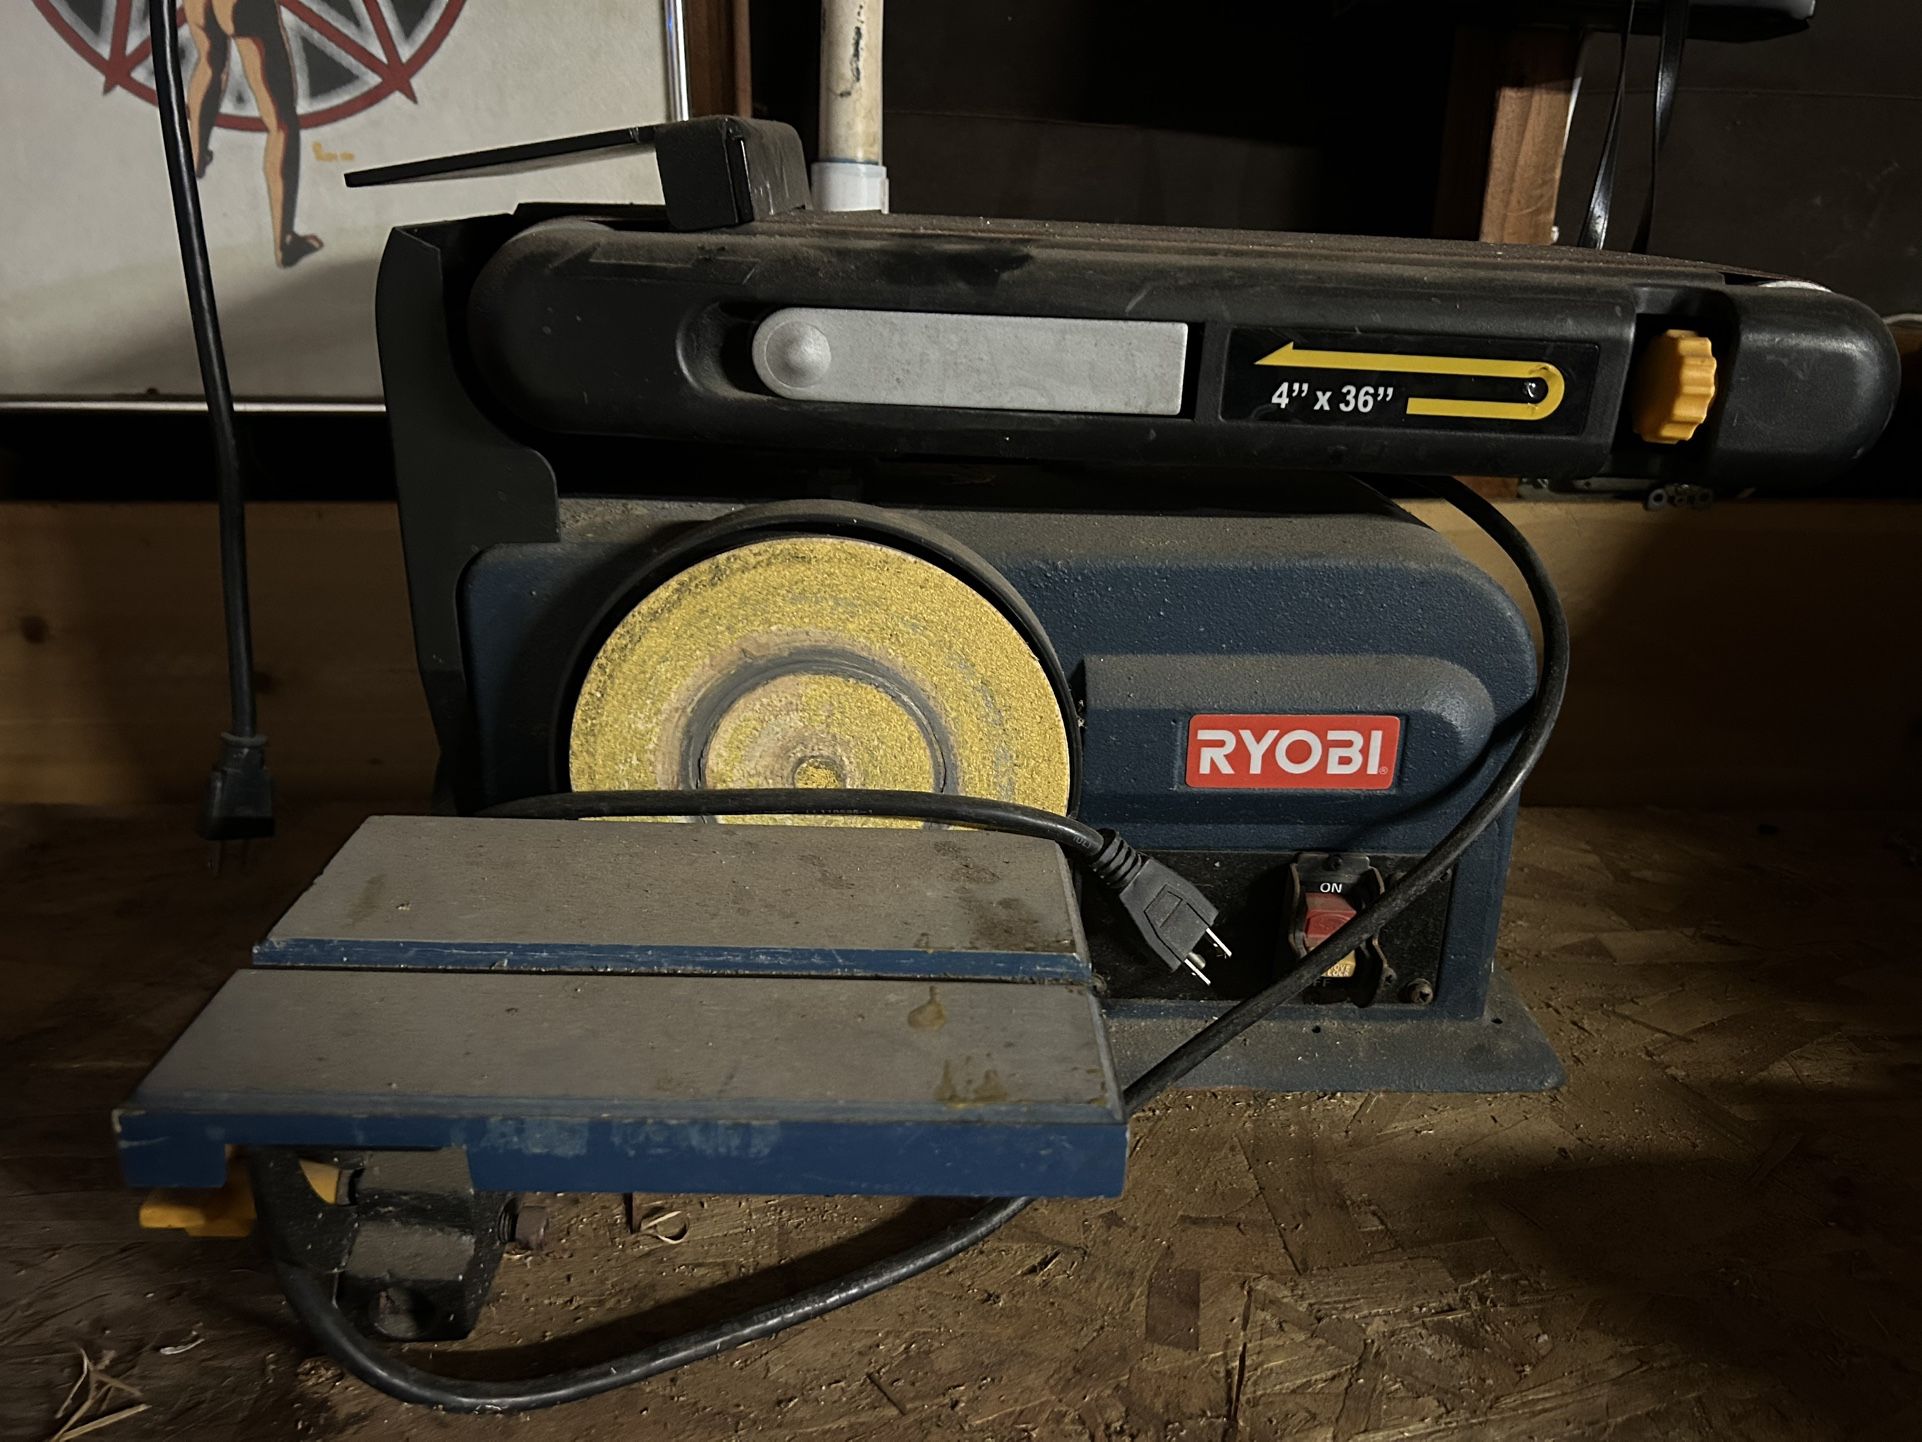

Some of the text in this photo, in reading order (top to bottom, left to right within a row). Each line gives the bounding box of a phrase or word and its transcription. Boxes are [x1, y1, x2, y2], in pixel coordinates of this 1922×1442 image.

[1313, 390, 1333, 411] x
[1196, 729, 1384, 775] RYOBI
[1319, 882, 1343, 894] ON
